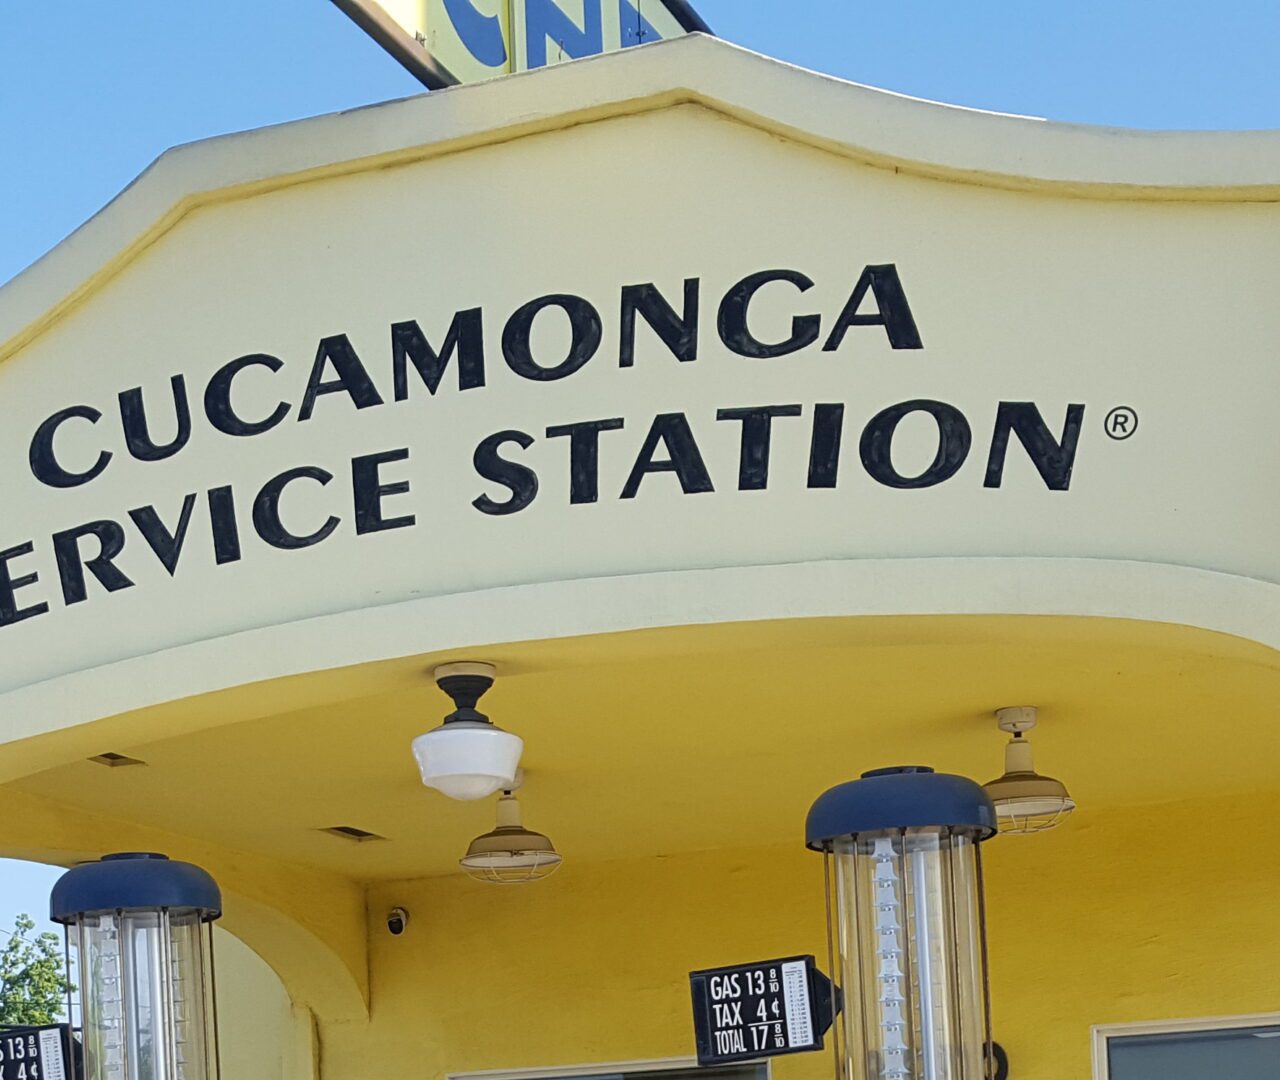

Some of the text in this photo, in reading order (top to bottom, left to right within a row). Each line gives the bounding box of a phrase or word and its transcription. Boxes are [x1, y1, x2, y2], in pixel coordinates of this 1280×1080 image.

[28, 263, 924, 488] CUCAMONGA
[472, 399, 1085, 516] STATION
[711, 974, 741, 1000] GAS
[746, 971, 764, 995] 13
[713, 1002, 743, 1027] TAX
[8, 1038, 25, 1060] 13
[715, 1029, 747, 1054] TOTAL
[751, 1026, 768, 1050] 17
